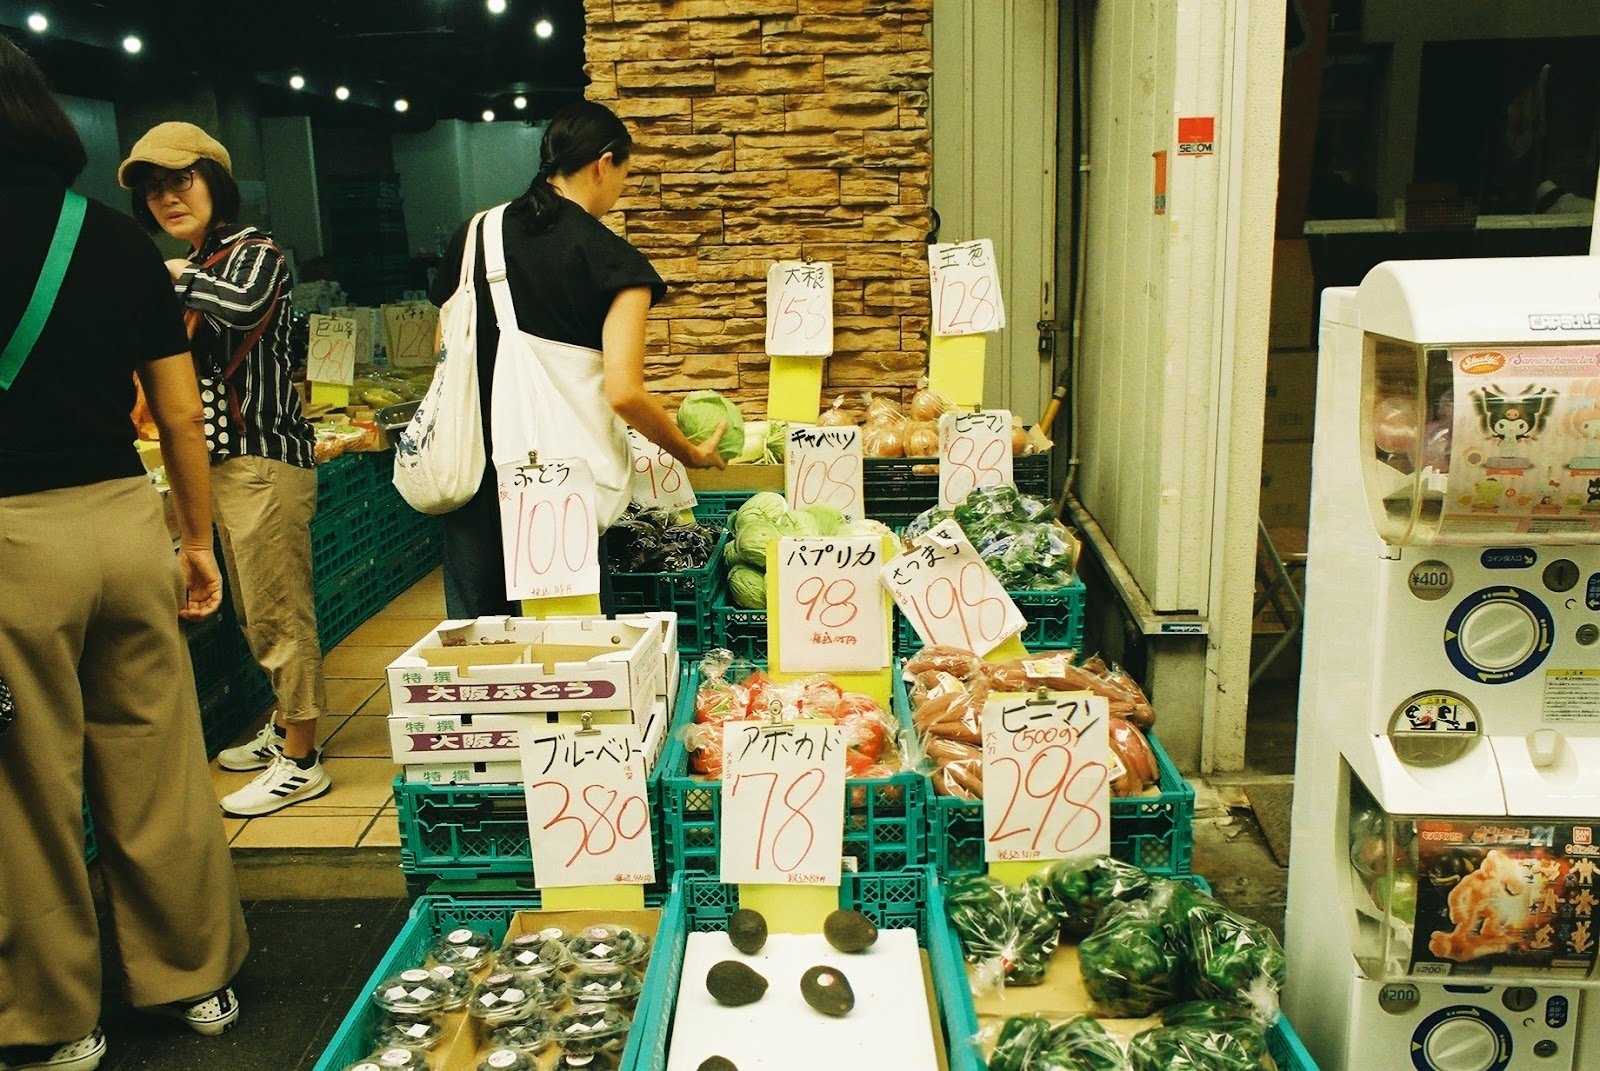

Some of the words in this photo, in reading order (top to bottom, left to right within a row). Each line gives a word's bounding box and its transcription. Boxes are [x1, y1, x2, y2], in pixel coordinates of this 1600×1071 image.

[1179, 143, 1212, 153] SECOM
[784, 265, 825, 290] 大根
[938, 275, 995, 332] 128
[791, 428, 856, 451] キャベツ
[955, 412, 1004, 434] ピーマン
[636, 450, 681, 500] 98
[793, 453, 858, 511] 108
[512, 491, 590, 588] 100
[786, 544, 877, 569] パプリカ
[1411, 571, 1448, 587] ¥400
[795, 576, 858, 628] 98
[910, 561, 1007, 652] 198
[402, 671, 452, 684] 特撰
[426, 680, 594, 702] 大阪ぶどう
[404, 720, 456, 733] 特撰
[1001, 697, 1100, 739] ピーマン
[533, 733, 642, 775] ブルーベリー
[738, 726, 842, 762] アボカド
[423, 769, 471, 782] 特撰
[988, 744, 1108, 854] 298
[531, 781, 649, 868] 380
[732, 767, 826, 873] 78
